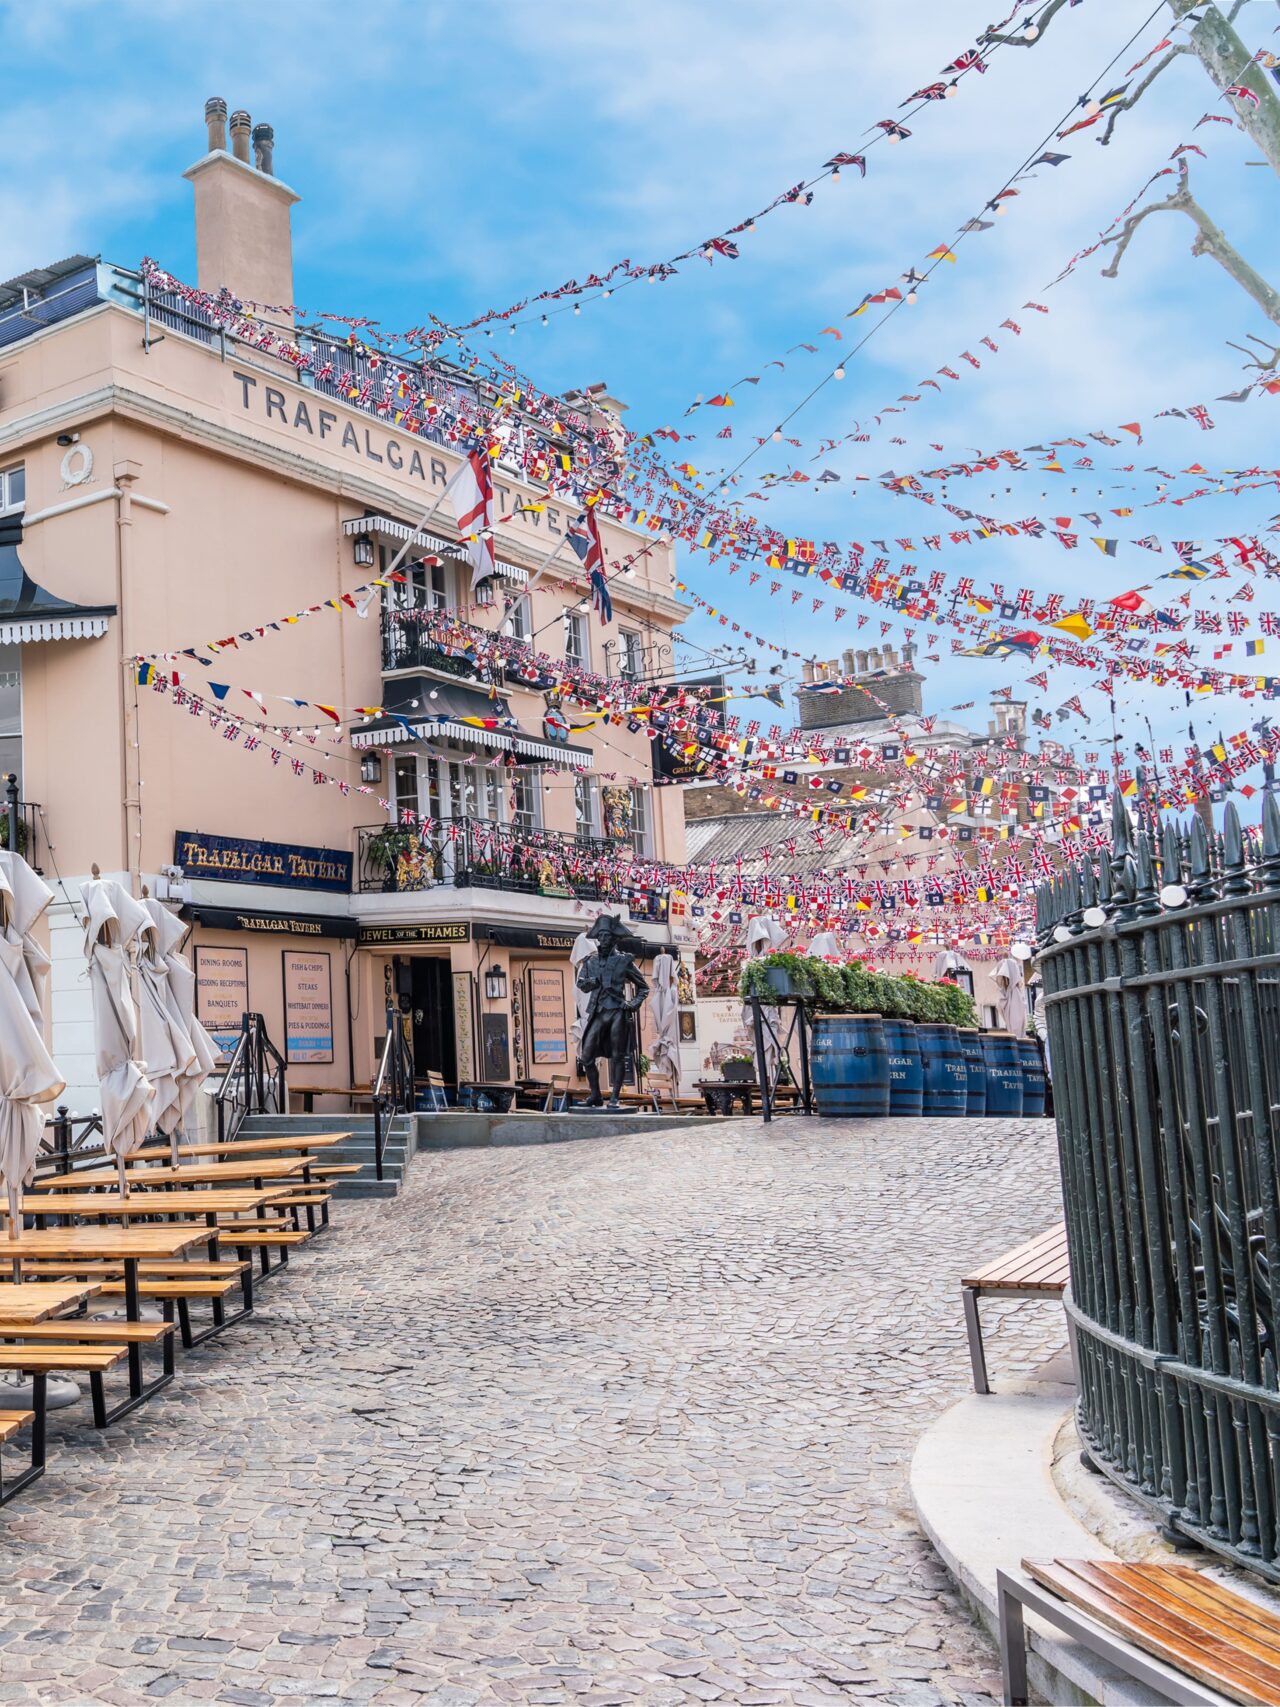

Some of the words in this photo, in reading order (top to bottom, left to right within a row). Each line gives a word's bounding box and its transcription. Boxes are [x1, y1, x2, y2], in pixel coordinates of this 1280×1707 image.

[232, 370, 448, 488] TRAFALGAR
[183, 842, 286, 875] TRAFALGAR
[287, 853, 348, 881] TAVERN
[237, 916, 289, 930] TRAFALGAR
[289, 920, 322, 934] TAVERN
[361, 930, 394, 941] JEWEL
[420, 926, 466, 938] THAMES
[199, 958, 221, 967] DINING
[222, 959, 243, 968] ROOMS
[291, 963, 304, 971] FISH
[308, 964, 324, 972] CHIPS
[297, 983, 318, 991] STEAKS
[207, 999, 238, 1008] BANQUETS
